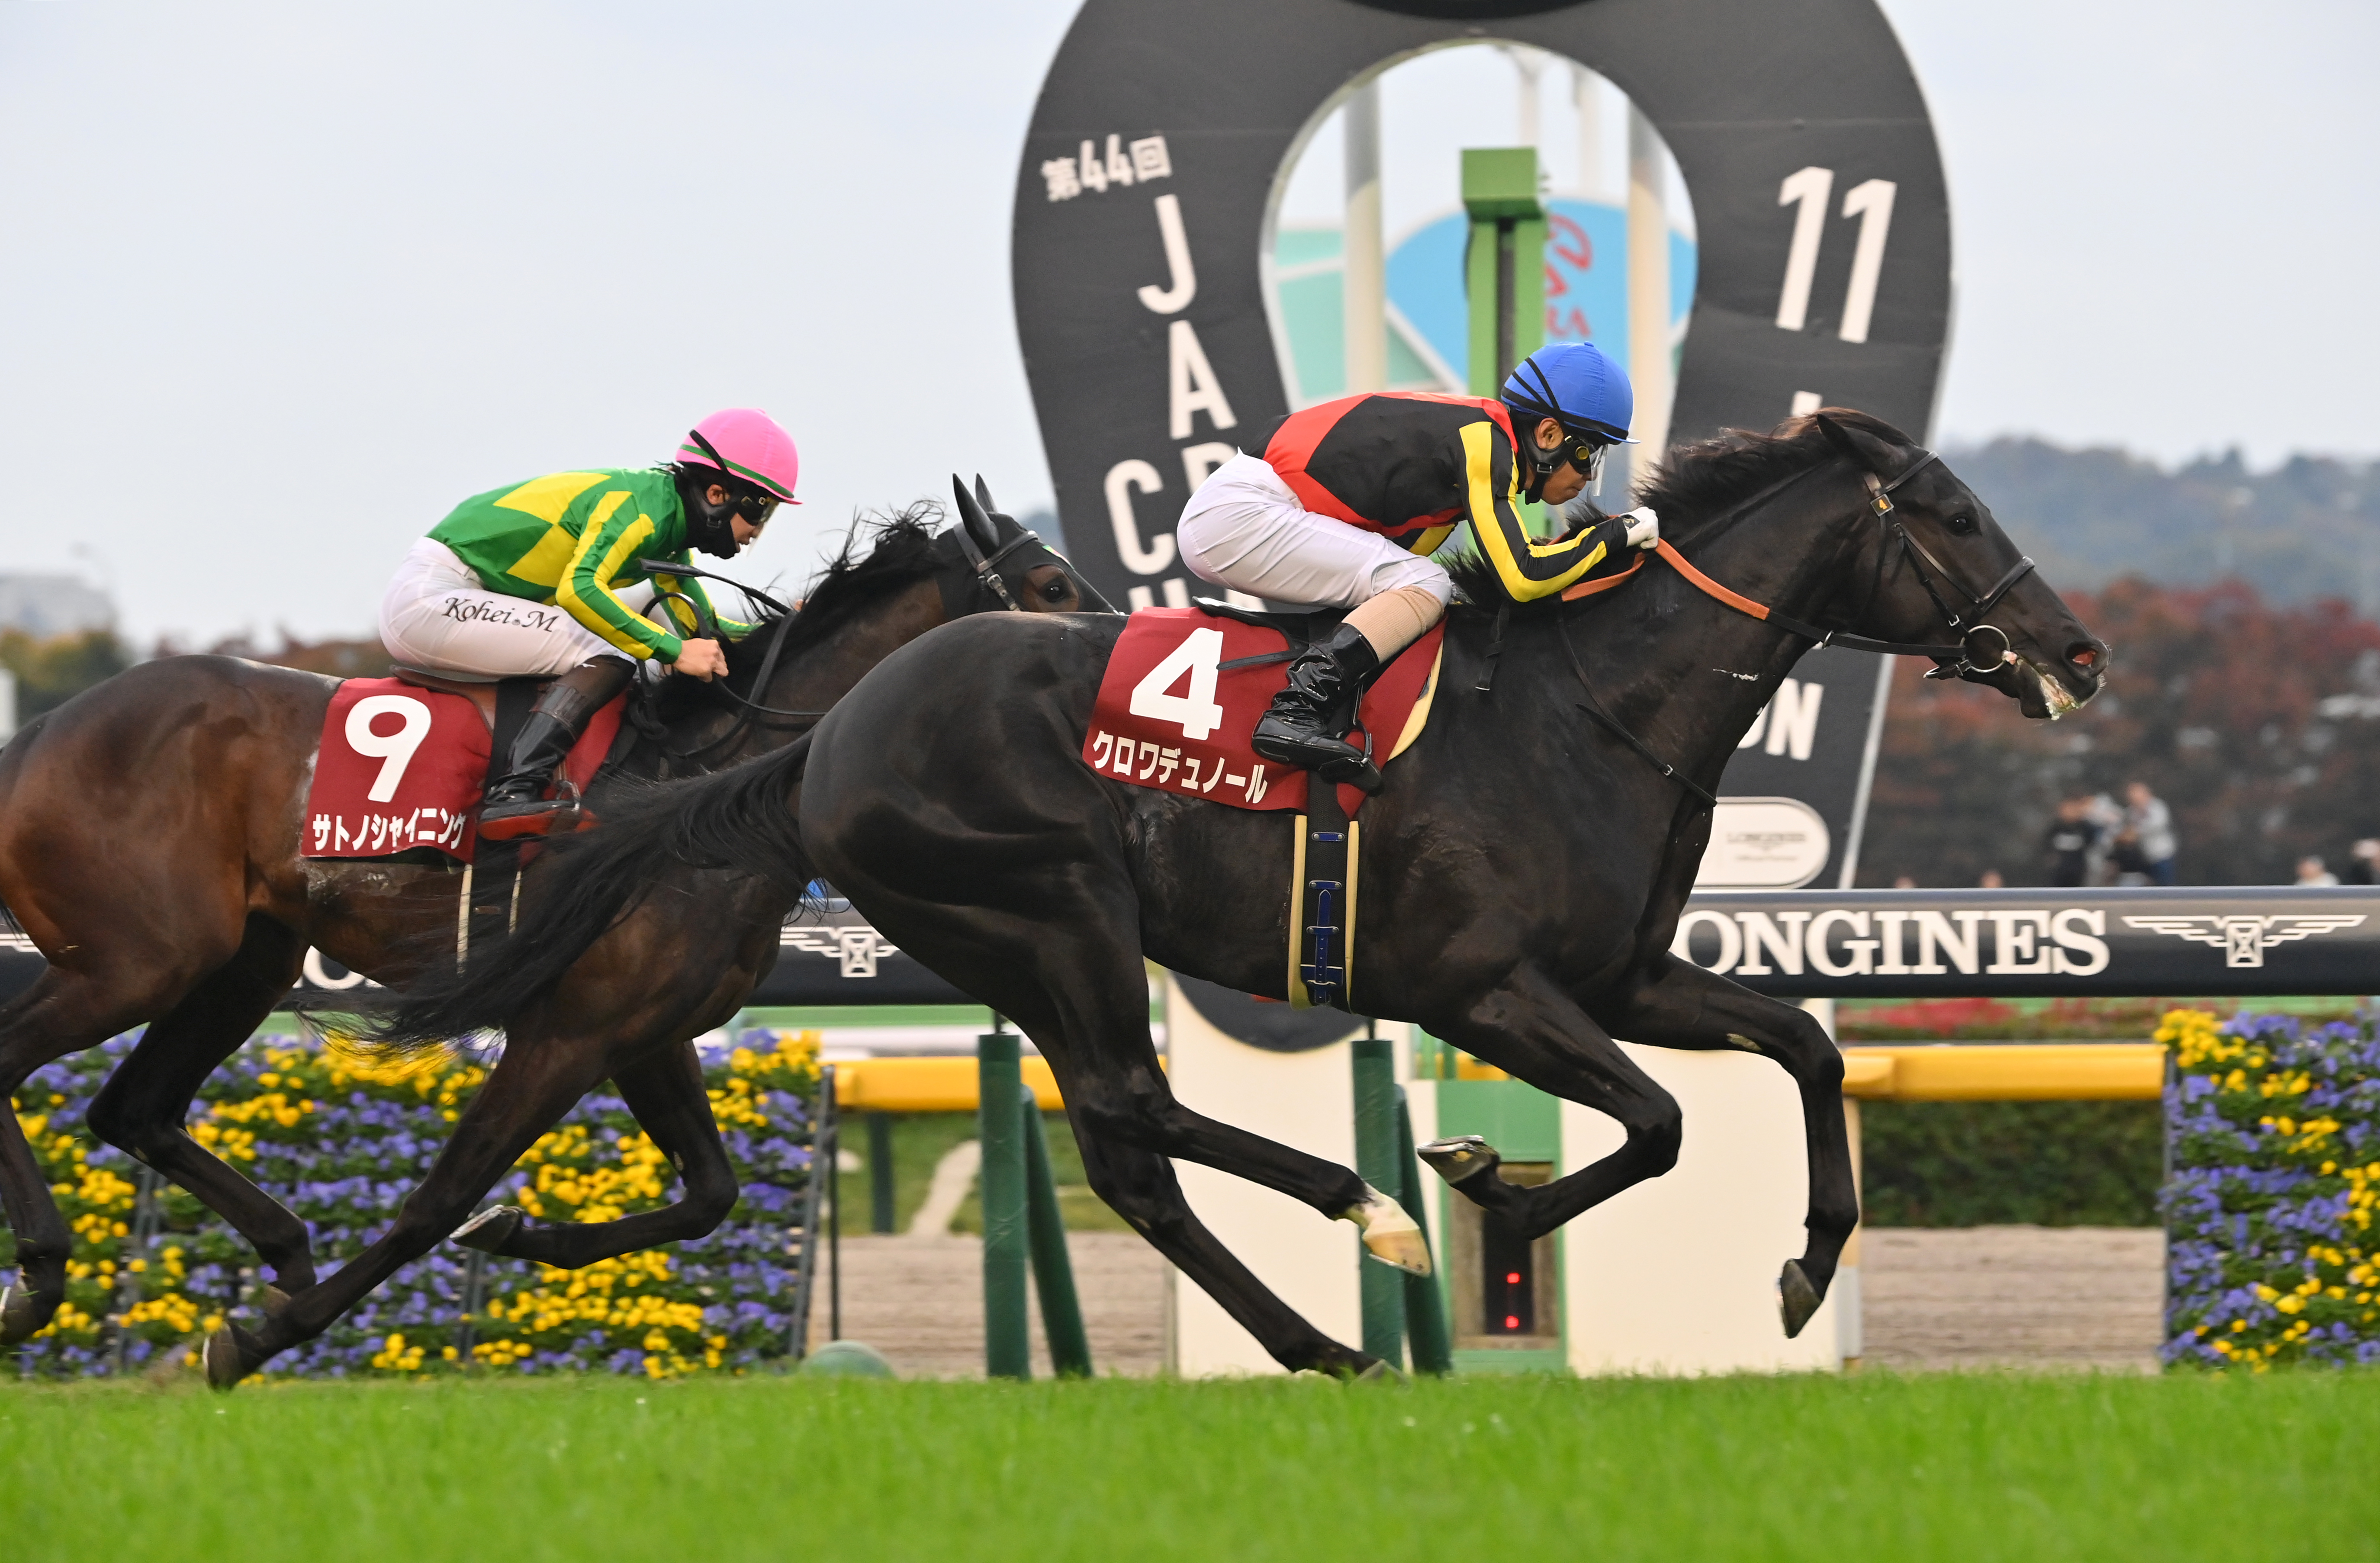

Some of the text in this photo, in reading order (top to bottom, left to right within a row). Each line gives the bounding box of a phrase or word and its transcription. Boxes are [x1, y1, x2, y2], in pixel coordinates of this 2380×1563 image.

[1040, 132, 1172, 203] 第44回
[1776, 166, 1898, 344] 11
[1879, 499, 1888, 510] 4
[1129, 627, 1224, 740] 4
[344, 695, 432, 803] 9
[1092, 730, 1268, 804] クロワデュノール
[1668, 908, 2111, 977] ONGINES
